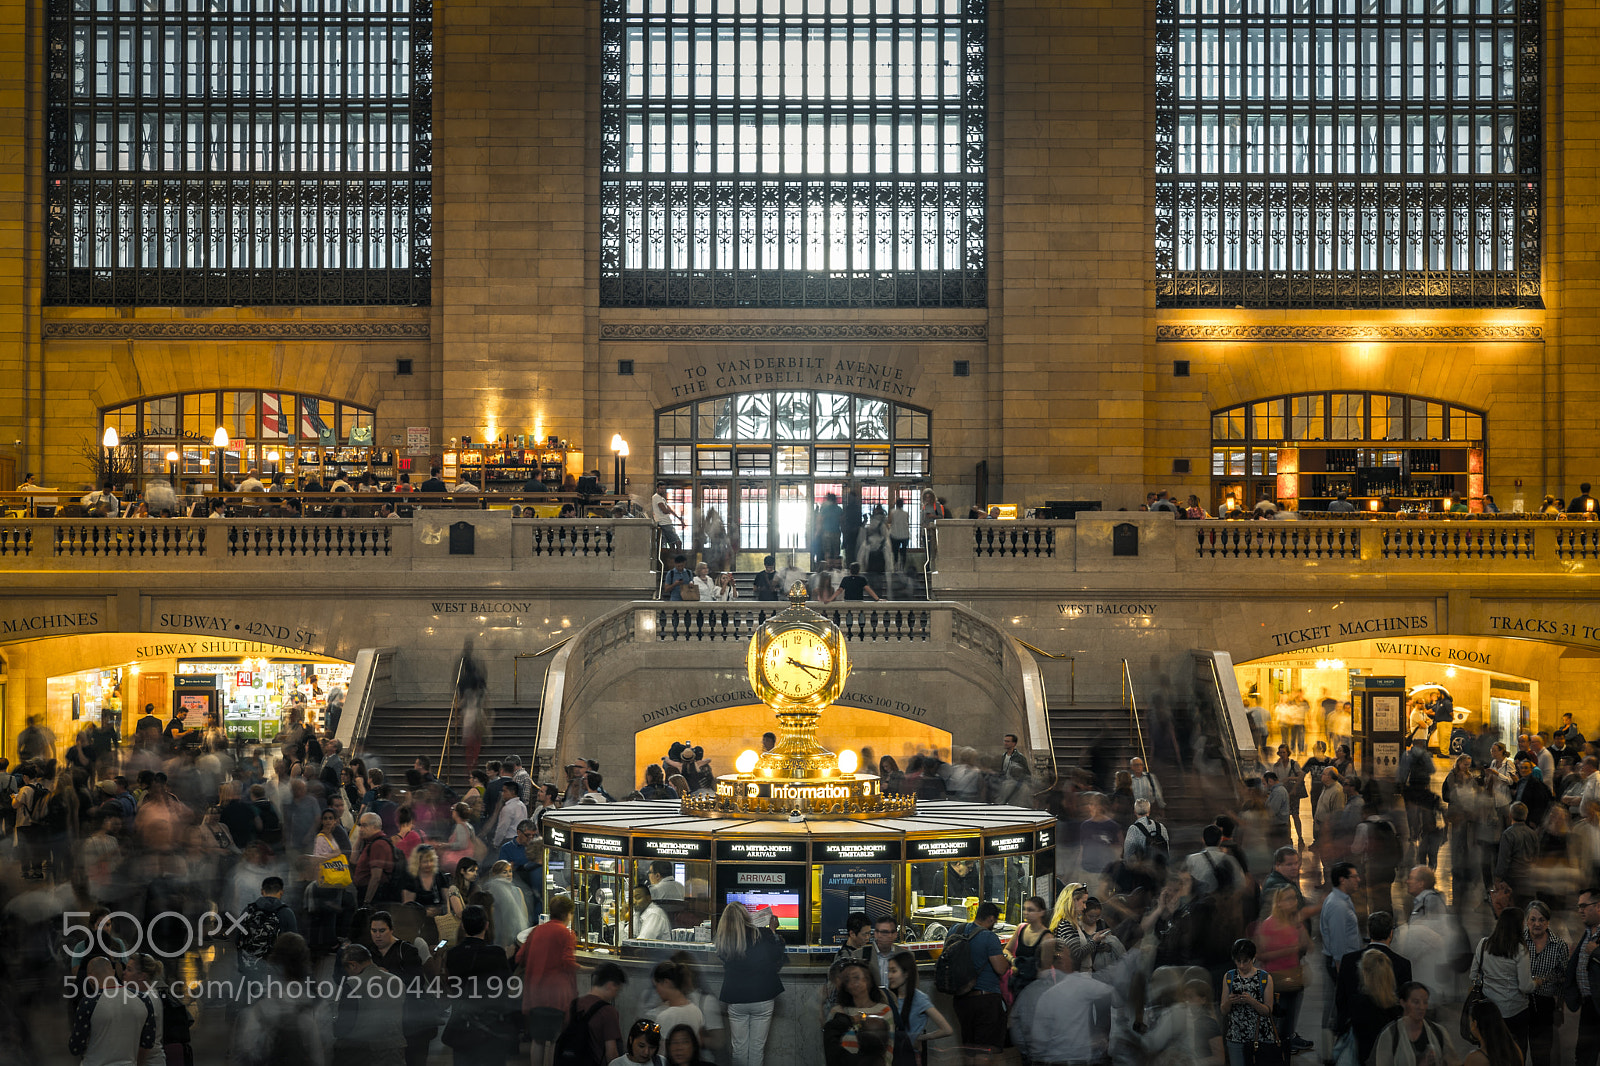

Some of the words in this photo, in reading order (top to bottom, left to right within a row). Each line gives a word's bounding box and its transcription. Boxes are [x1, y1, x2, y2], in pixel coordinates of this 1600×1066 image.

[684, 365, 707, 379] TO
[716, 357, 825, 374] VANDERBILT
[835, 360, 903, 380] AVENUE
[671, 380, 706, 397] THE
[716, 371, 804, 389] CAMPBELL
[814, 373, 916, 398] APARTMENT
[230, 440, 244, 451] EXIT
[398, 458, 412, 470] EXIT
[431, 602, 467, 613] WEST
[470, 602, 532, 613] BALCONY
[1057, 604, 1092, 615] WEST
[1096, 604, 1157, 615] BALCONY
[2, 612, 98, 634] MACHINES
[1490, 616, 1557, 634] TRACKS
[1561, 623, 1576, 637] 31
[160, 613, 232, 632] SUBWAY
[245, 621, 290, 640] 42ND
[294, 629, 317, 646] ST
[1271, 624, 1331, 647] TICKET
[1338, 615, 1429, 636] MACHINES
[782, 639, 788, 648] 11
[793, 635, 801, 645] 12
[136, 641, 198, 658] SUBWAY
[201, 640, 267, 653] SHUTTLE
[772, 648, 780, 658] 10
[816, 646, 822, 656] 2
[1376, 642, 1441, 658] WAITING
[1448, 648, 1491, 665] ROOM
[770, 660, 776, 670] 9
[773, 673, 780, 682] 8
[818, 672, 823, 682] 4
[783, 680, 788, 690] 7
[794, 684, 801, 694] 6
[806, 681, 813, 691] 5
[838, 691, 873, 704] RACKS
[876, 697, 892, 708] 100
[895, 702, 911, 712] TO
[912, 706, 927, 717] 117
[642, 702, 688, 724] DINING
[770, 783, 850, 799] Information
[659, 842, 699, 850] METRO-NORTH
[740, 874, 783, 883] ARRIVALS
